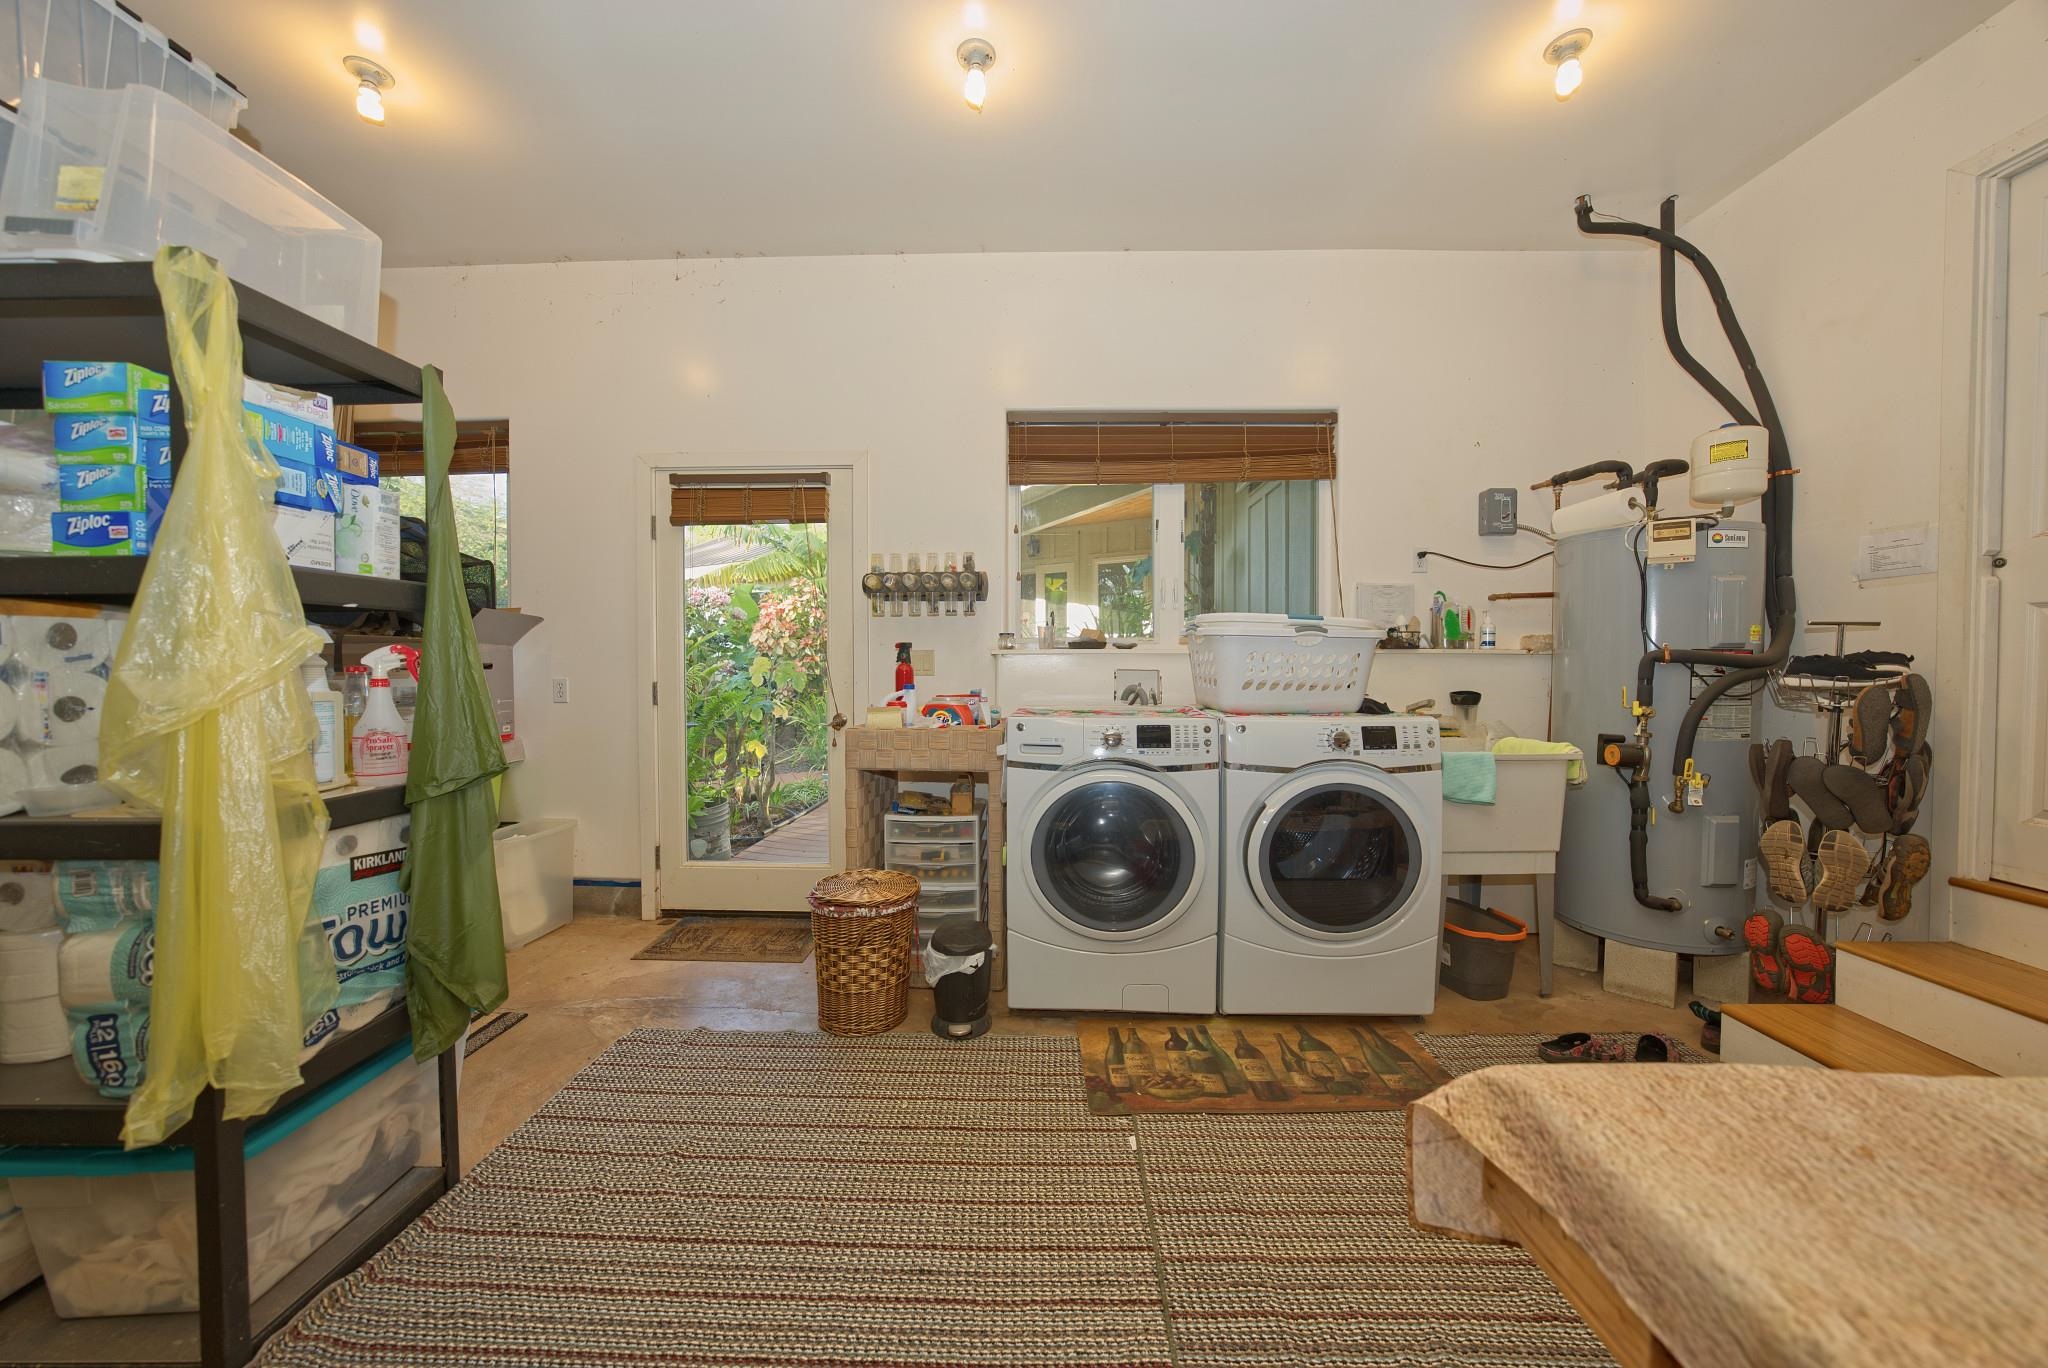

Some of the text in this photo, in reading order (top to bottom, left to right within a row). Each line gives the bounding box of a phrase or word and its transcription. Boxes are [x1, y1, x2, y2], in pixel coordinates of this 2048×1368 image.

[321, 432, 335, 463] Ziploc
[77, 467, 112, 488] Ziploc
[351, 488, 361, 513] Dove
[67, 514, 111, 535] Ziploc
[96, 1017, 116, 1042] 12
